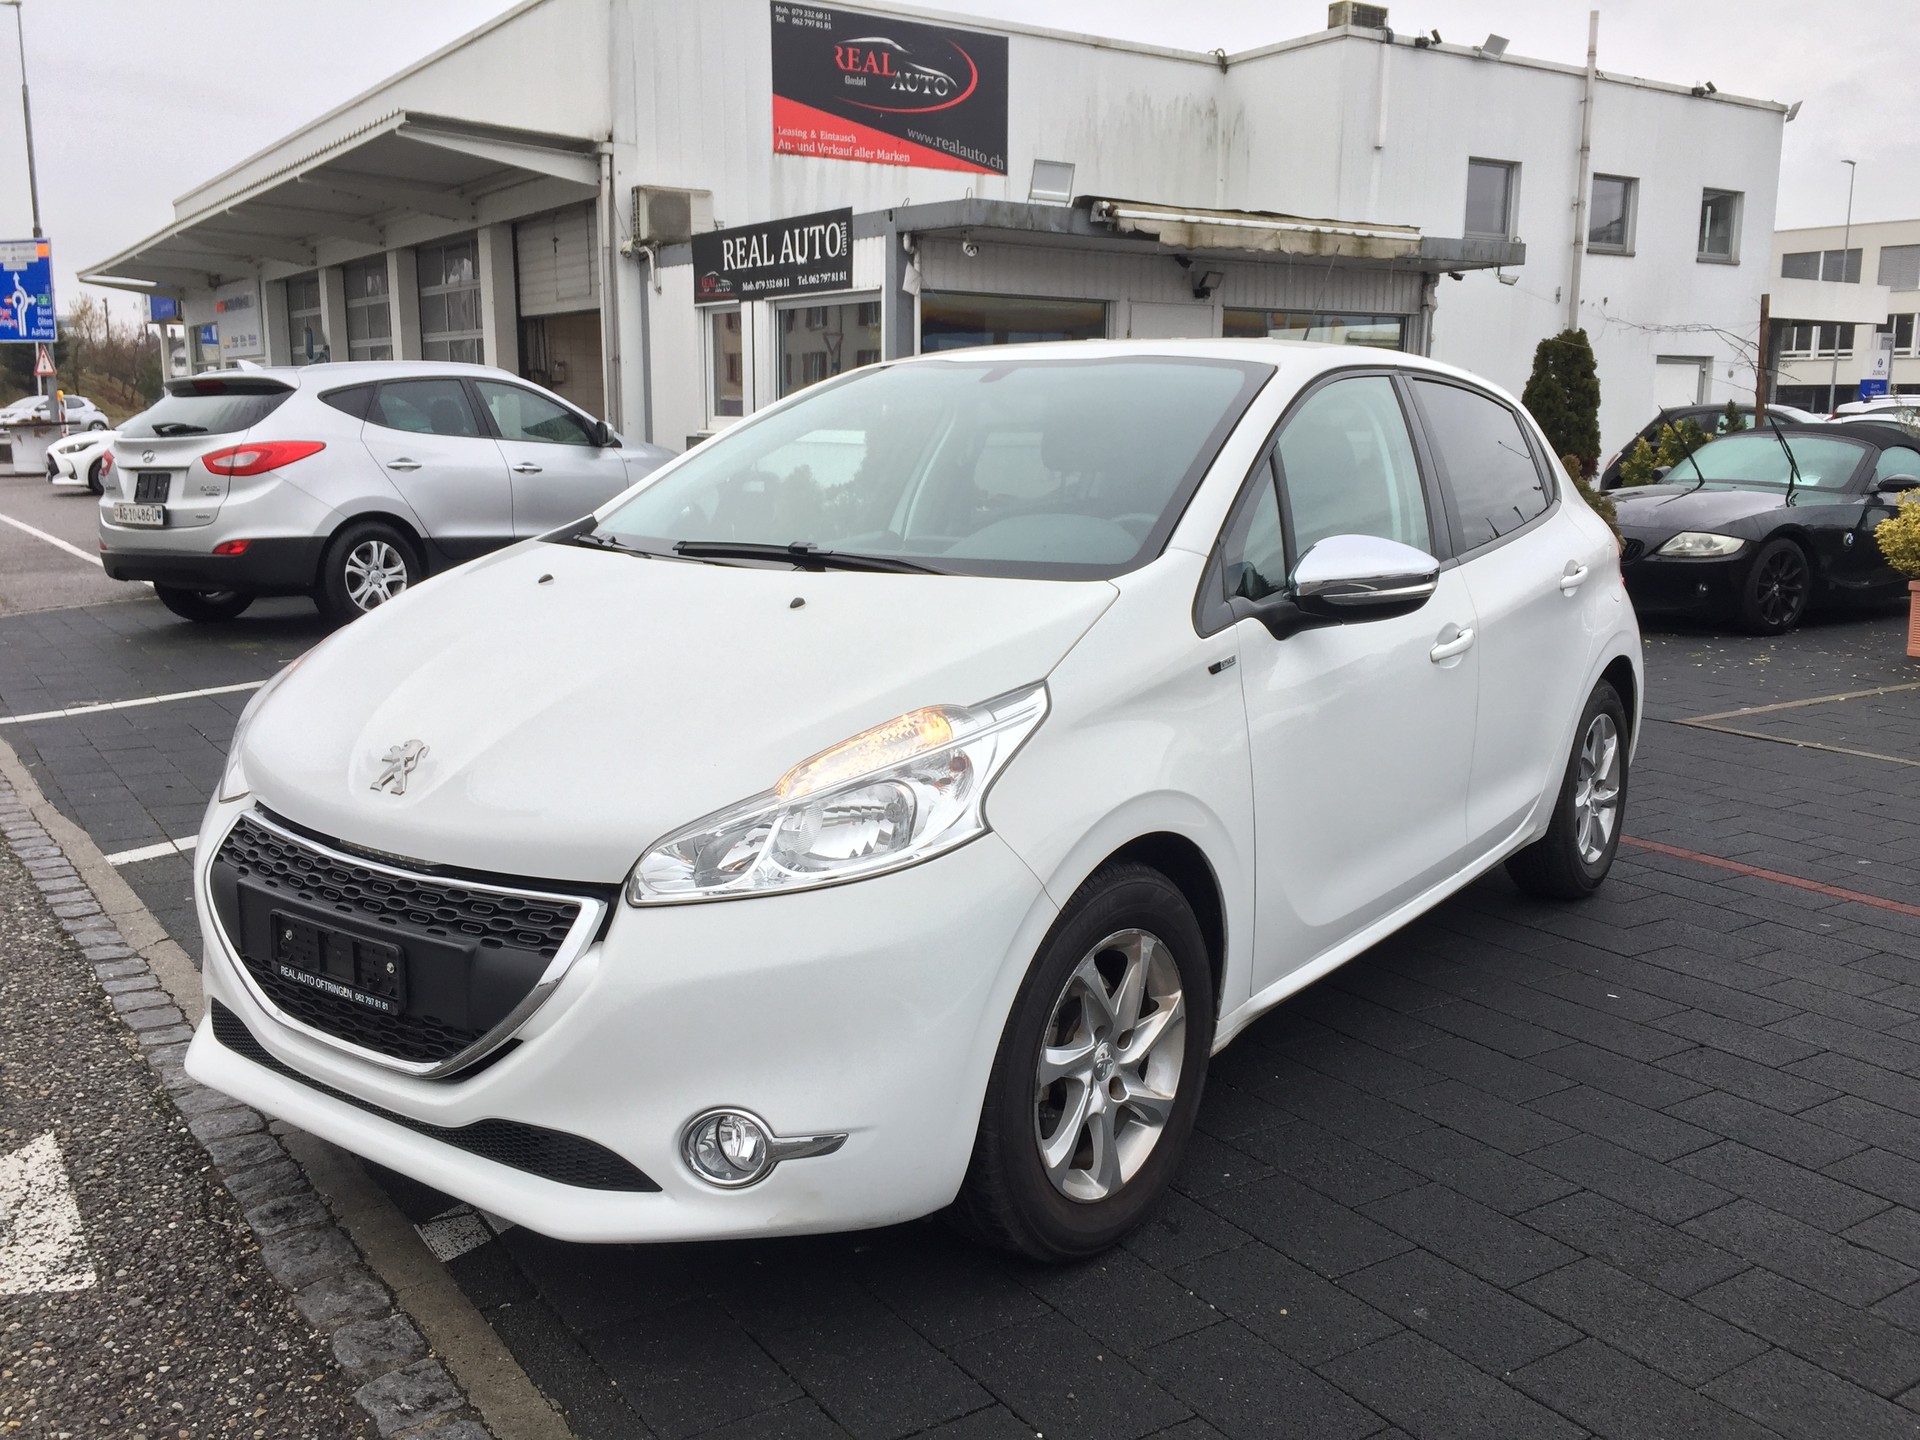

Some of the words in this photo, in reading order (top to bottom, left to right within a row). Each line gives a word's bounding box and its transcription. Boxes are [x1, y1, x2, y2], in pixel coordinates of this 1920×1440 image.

[791, 8, 803, 16] 079
[803, 9, 815, 18] 332
[815, 12, 824, 20] 68
[824, 13, 831, 21] 11
[791, 17, 804, 26] 062
[804, 18, 815, 27] 797
[815, 21, 824, 29] 81
[824, 22, 832, 30] 81
[834, 45, 896, 77] REAL
[844, 74, 867, 87] GmbH
[890, 71, 949, 96] AUTO
[777, 126, 808, 139] Leasing
[810, 130, 817, 138] &
[820, 130, 857, 144] Eintausch
[777, 139, 795, 150] An-
[797, 141, 816, 152] und
[818, 142, 853, 157] Verkauf
[854, 146, 875, 159] aller
[877, 149, 911, 162] Marken
[907, 127, 1004, 170] www.realauto.ch
[722, 233, 775, 271] REAL
[779, 222, 841, 265] AUTO
[840, 222, 848, 257] GmbH
[742, 281, 755, 291] Mob.
[755, 280, 765, 290] 079
[766, 279, 775, 289] 332
[776, 278, 783, 288] 68
[783, 278, 790, 287] 11
[797, 274, 808, 285] Tel.
[809, 273, 819, 284] 062
[820, 272, 831, 283] 797
[831, 271, 839, 282] 81
[840, 270, 847, 281] 81
[37, 306, 52, 316] Basel
[37, 316, 53, 327] Olten
[31, 327, 54, 339] Aarburg
[280, 965, 297, 980] REAL
[297, 971, 315, 986] AUTO
[354, 992, 365, 1003] 062
[365, 996, 375, 1006] 797
[374, 999, 381, 1008] 81
[381, 1001, 389, 1010] 81
